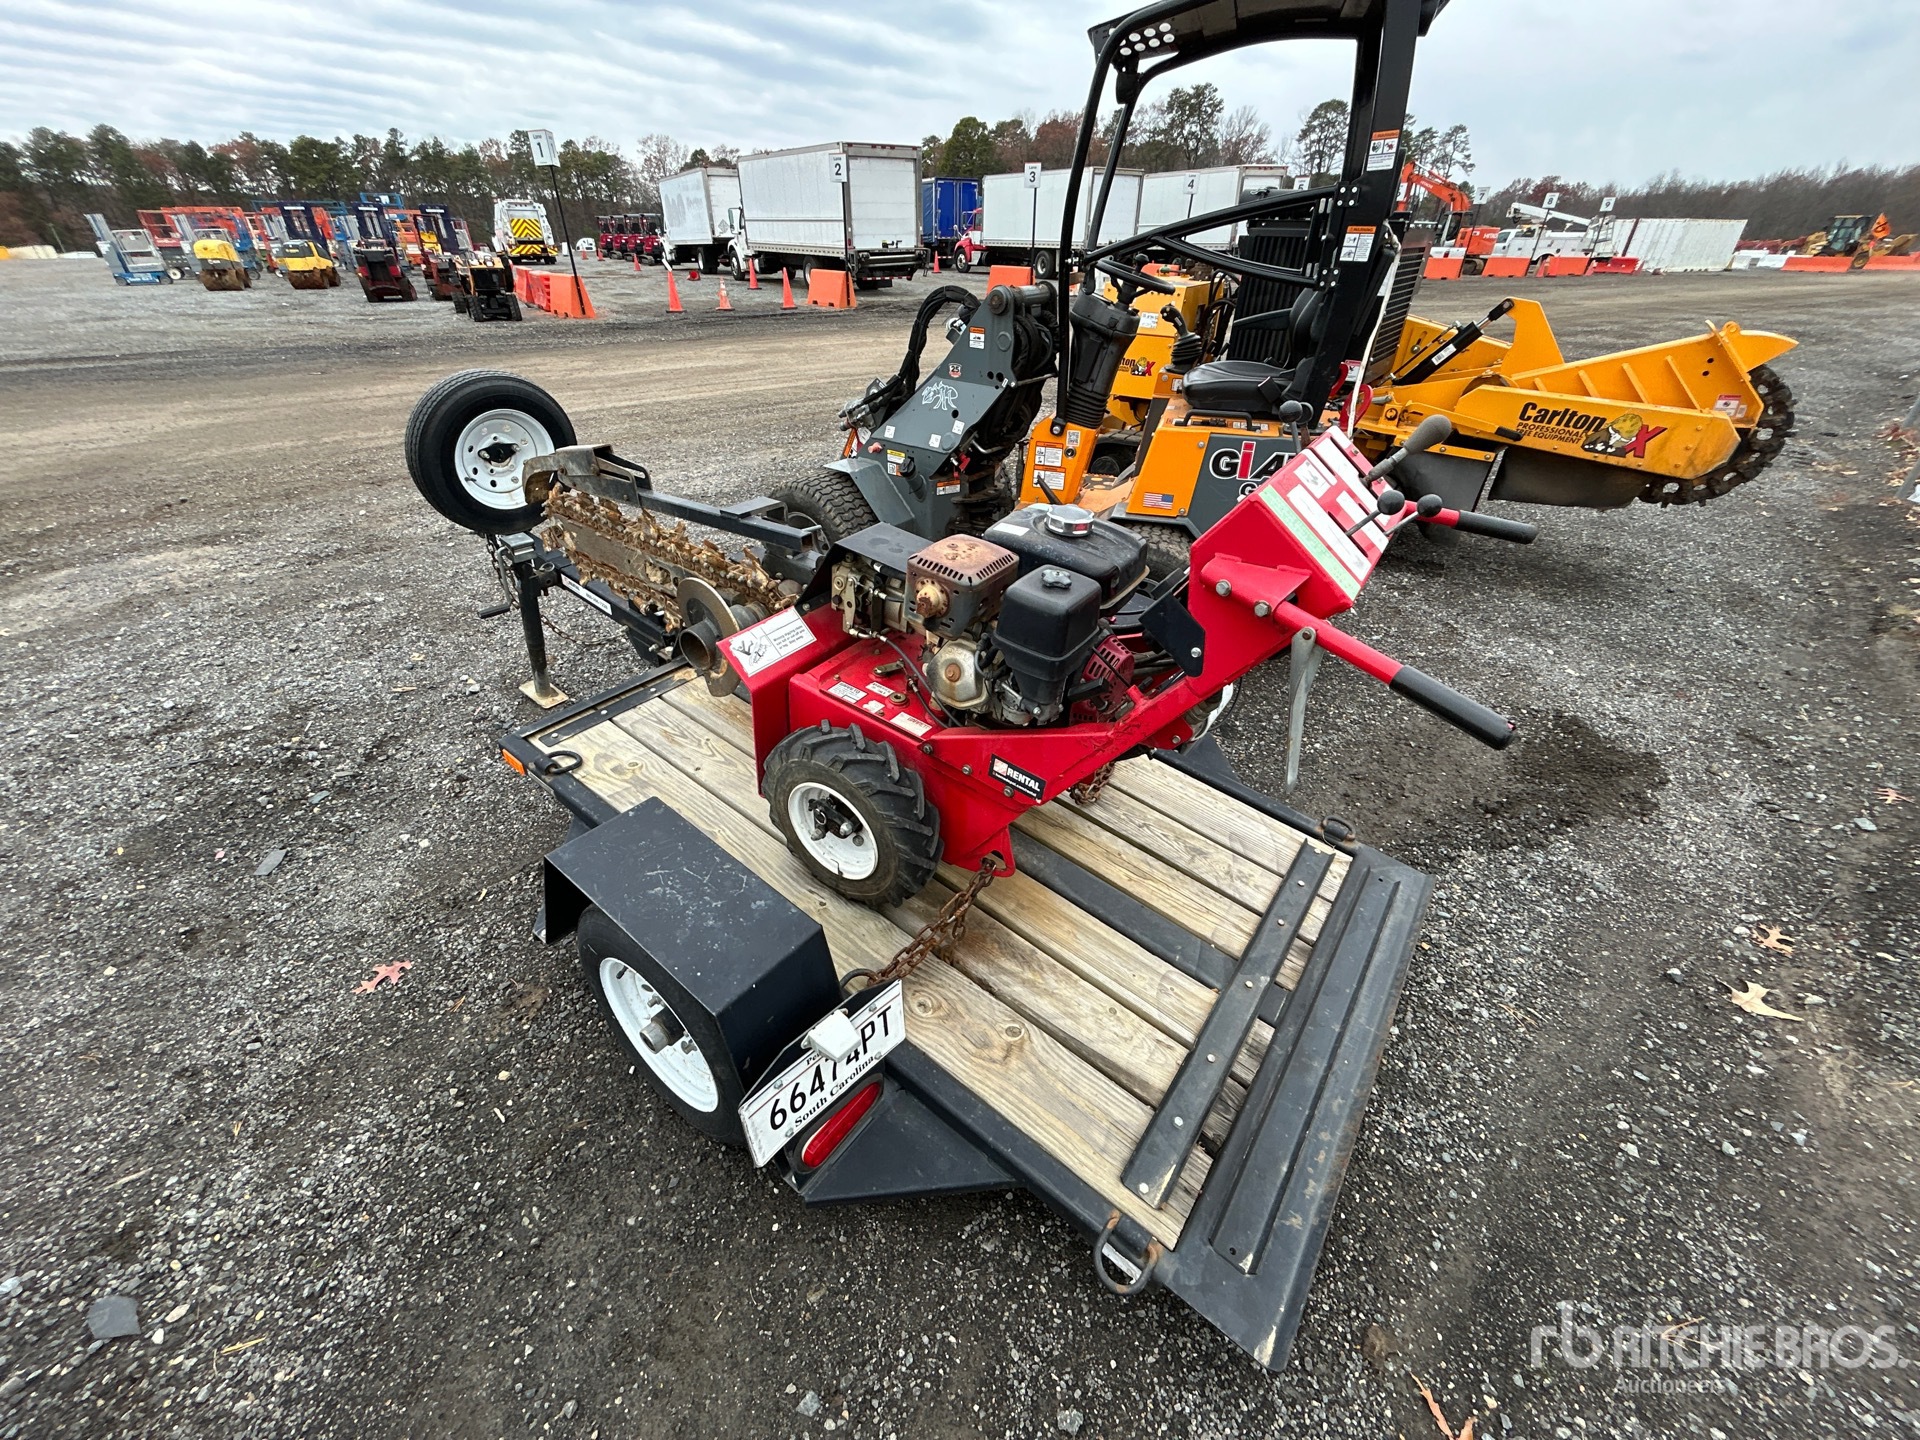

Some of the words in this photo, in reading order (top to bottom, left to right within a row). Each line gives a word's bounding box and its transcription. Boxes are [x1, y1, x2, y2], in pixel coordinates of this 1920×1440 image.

[537, 142, 544, 158] 1
[834, 162, 842, 176] 2
[1029, 171, 1036, 183] 3
[1188, 179, 1195, 189] 4
[1479, 192, 1485, 201] 7
[1547, 197, 1554, 205] 8
[1605, 201, 1611, 209] 9
[1519, 401, 1607, 433] Carlton
[1516, 421, 1585, 439] PROFESSIONAL
[1533, 430, 1582, 445] EQUIPMENT
[1007, 767, 1041, 792] RENTAL
[794, 1096, 828, 1128] South
[830, 1056, 874, 1097] Carolina
